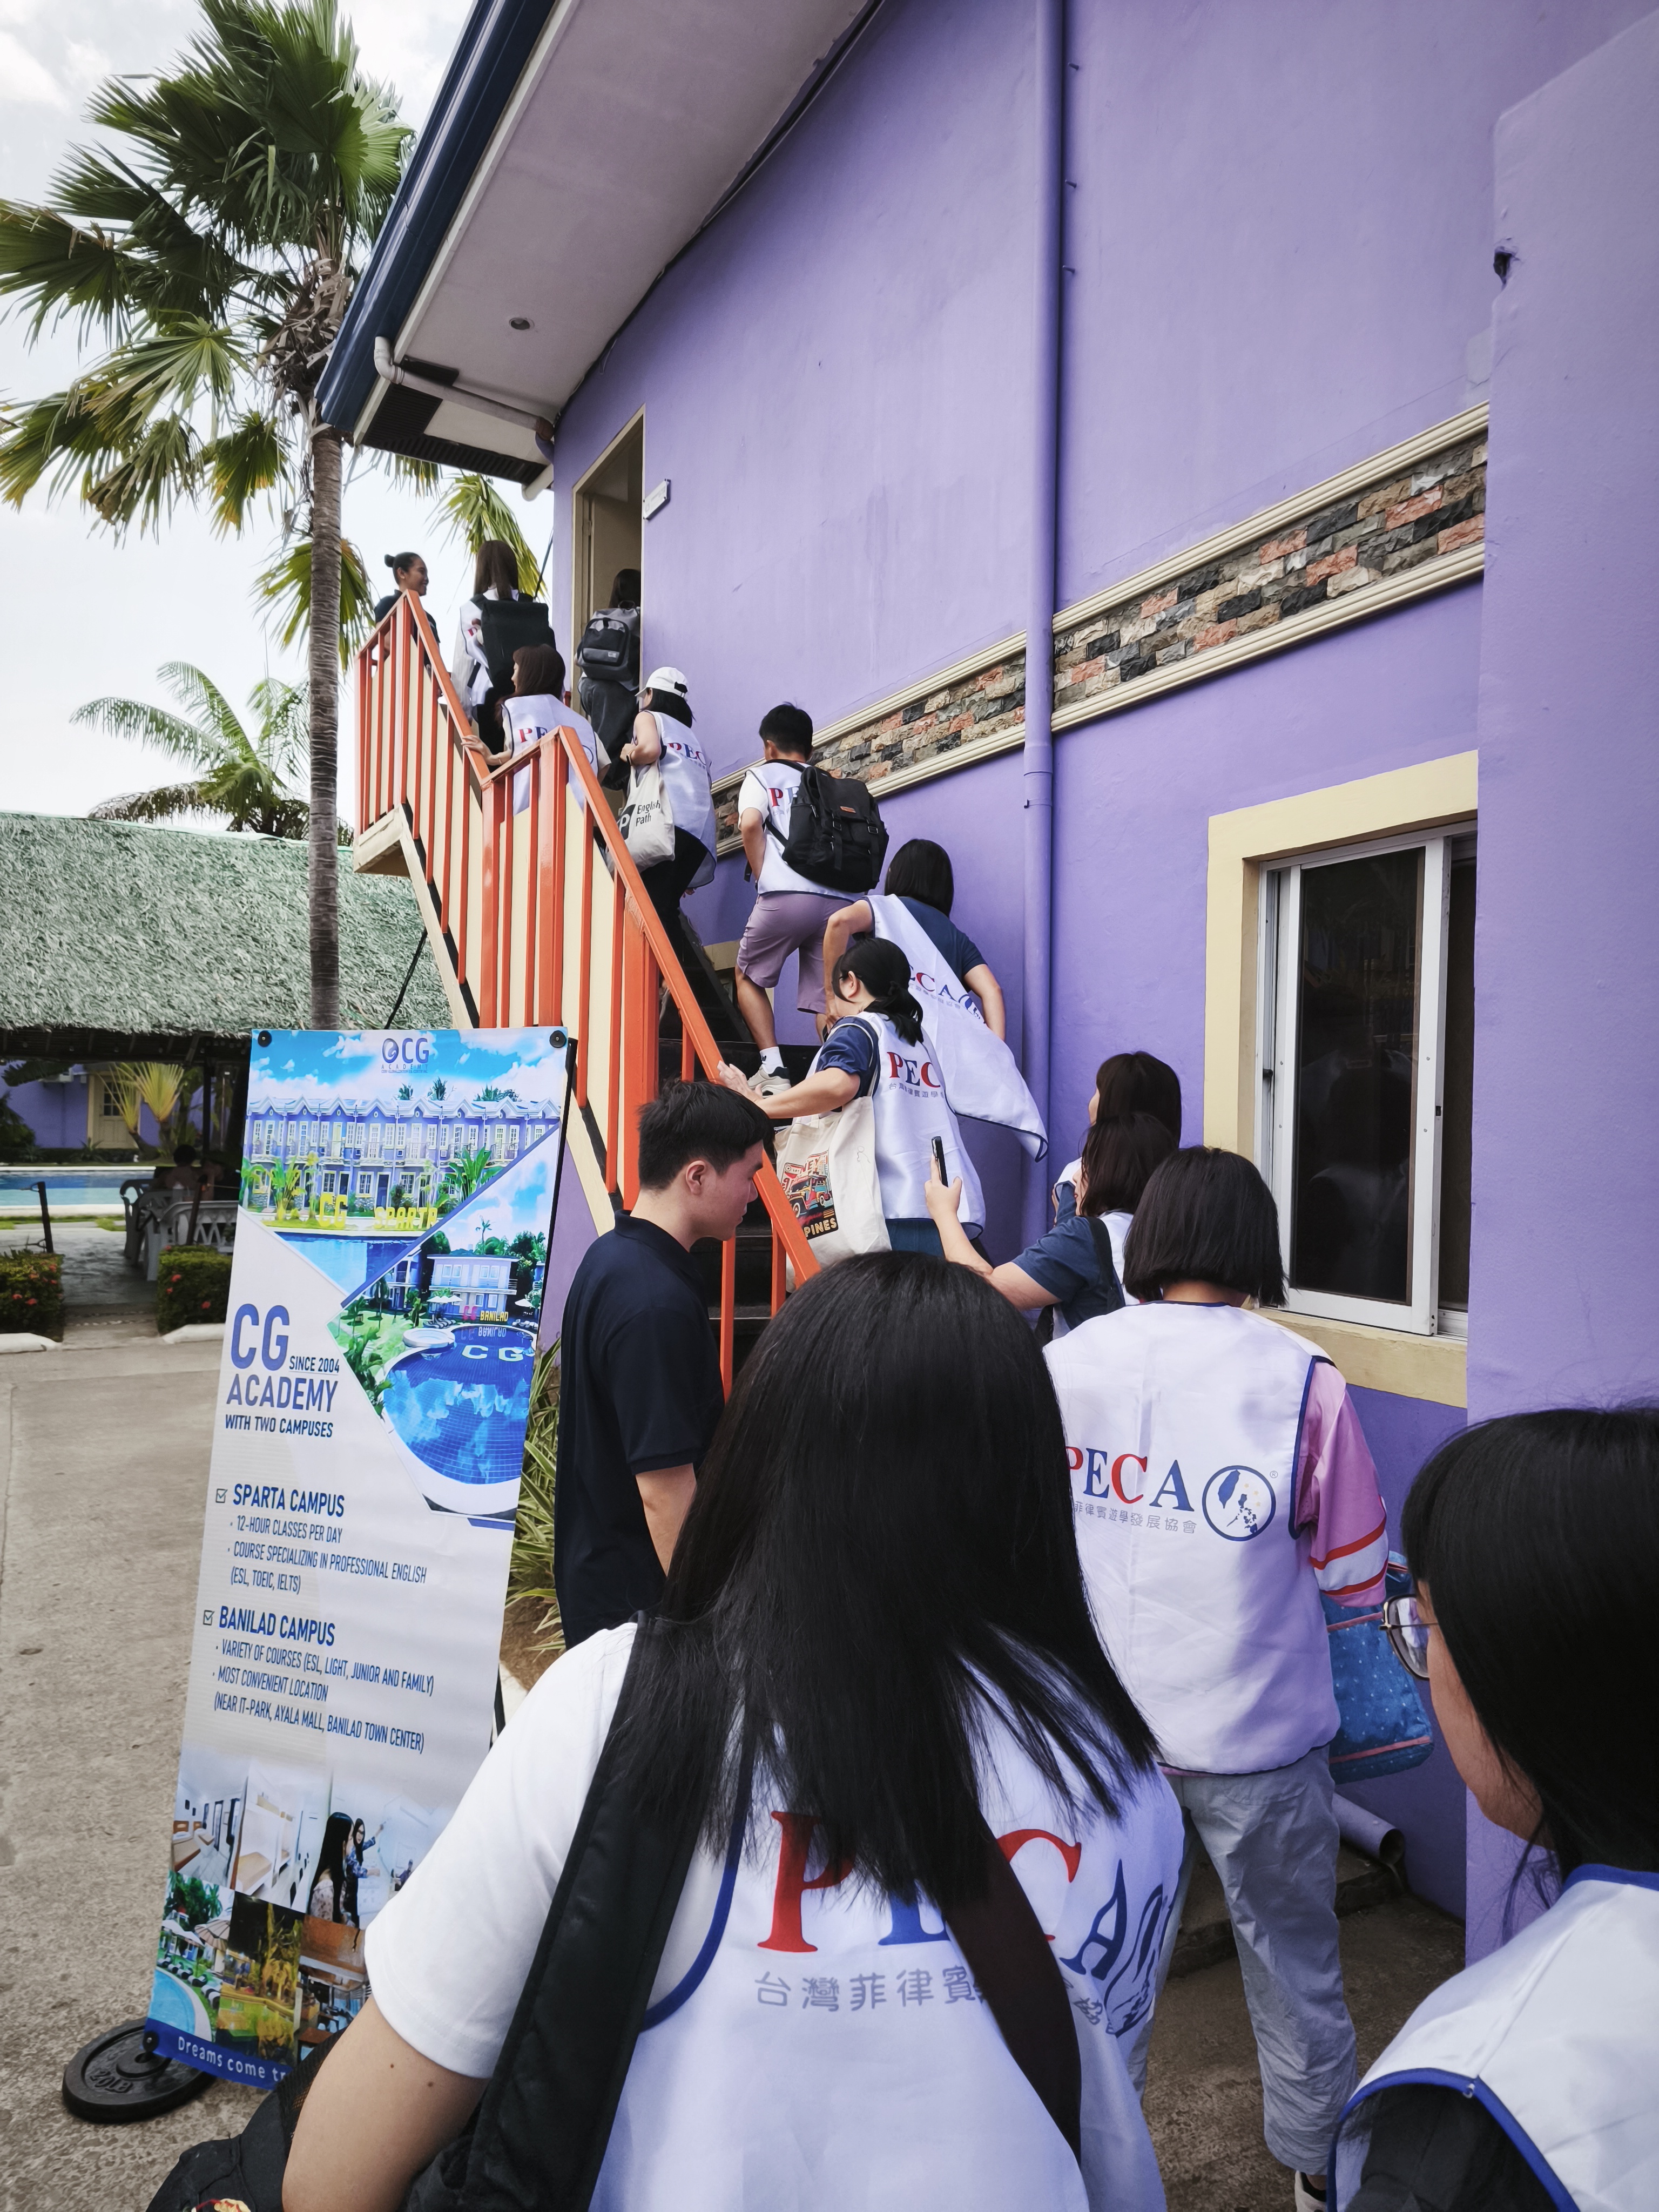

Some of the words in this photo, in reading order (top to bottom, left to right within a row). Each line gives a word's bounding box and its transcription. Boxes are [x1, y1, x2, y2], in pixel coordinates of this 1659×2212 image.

[637, 800, 660, 814] English
[319, 1193, 348, 1229] CG
[480, 1310, 509, 1322] BANILAD
[231, 1304, 290, 1371] CG
[289, 1355, 315, 1372] SINCE
[318, 1357, 340, 1373] 2004
[226, 1373, 338, 1412] ACADEMY
[226, 1414, 251, 1431] WITH
[255, 1416, 276, 1432] TWO
[279, 1418, 333, 1438] CAMPUSES
[233, 1483, 285, 1510] SPARTA
[290, 1489, 345, 1518] CAMPUS
[237, 1515, 271, 1534] 12-HOUR
[272, 1519, 307, 1539] CLASSES
[309, 1524, 325, 1541] PER
[326, 1526, 343, 1543] DAY
[234, 1541, 266, 1560] COURSE
[267, 1545, 318, 1568] SPECIALIZING
[319, 1553, 328, 1569] IN
[329, 1554, 388, 1579] PROFESSIONAL
[391, 1562, 427, 1583] ENGLISH
[231, 1566, 249, 1587] (ESL,
[252, 1569, 275, 1591] TOEIC,
[277, 1573, 301, 1595] IELTS)
[219, 1605, 276, 1636] BANILAD
[279, 1615, 335, 1647] CAMPUS
[218, 1665, 241, 1684] MOST
[241, 1669, 289, 1694] CONVENIENT
[289, 1678, 329, 1702] LOCATION
[222, 1638, 253, 1660] VARIETY
[254, 1644, 265, 1661] OF
[266, 1646, 302, 1668] COURSES
[304, 1652, 322, 1675] (ESL,
[325, 1657, 348, 1680] LIGHT,
[350, 1662, 380, 1683] JUNIOR
[381, 1668, 400, 1687] AND
[401, 1671, 434, 1697] FAMILY)
[214, 1691, 238, 1712] (NEAR
[239, 1697, 272, 1722] IT-PARK,
[274, 1704, 299, 1725] AYALA
[301, 1709, 325, 1734] MALL,
[327, 1715, 362, 1738] BANILAD
[365, 1722, 388, 1743] TOWN
[389, 1728, 424, 1755] CENTER)
[178, 2036, 222, 2067] Dreams
[227, 2058, 266, 2079] come
